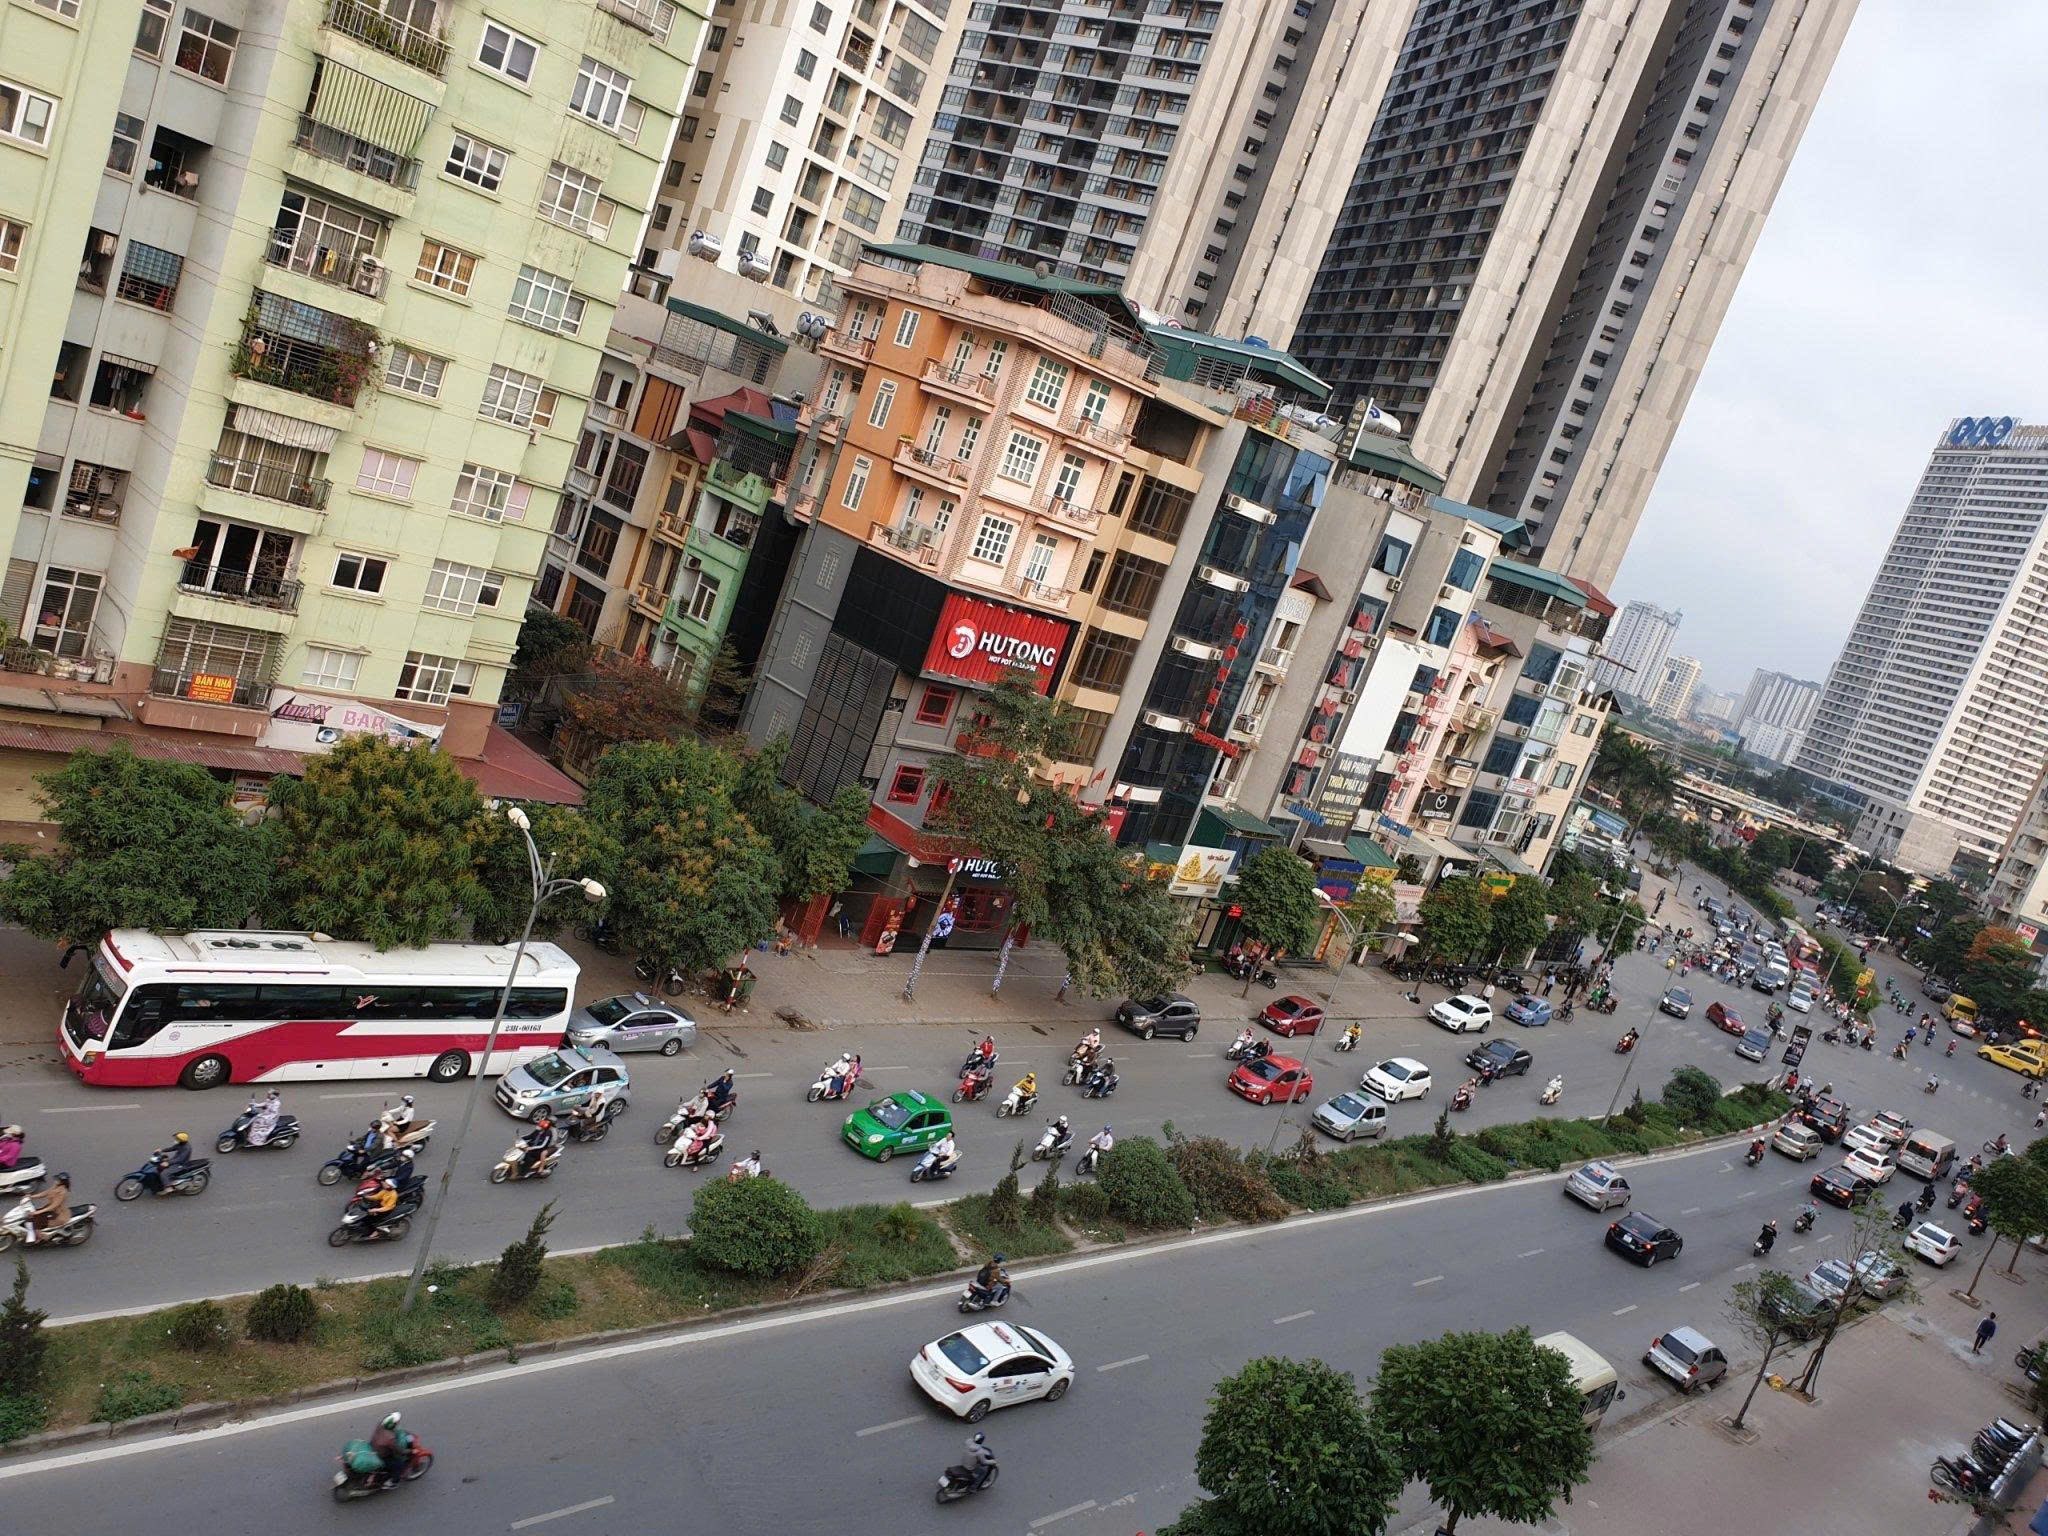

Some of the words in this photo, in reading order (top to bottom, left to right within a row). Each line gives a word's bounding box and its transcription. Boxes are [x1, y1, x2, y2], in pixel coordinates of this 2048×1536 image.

[978, 631, 1056, 667] HUTONG
[988, 655, 1000, 664] HOT
[1000, 658, 1013, 667] POT
[195, 674, 213, 686] BÁN
[214, 677, 233, 689] NHÀ
[343, 710, 386, 732] BAR
